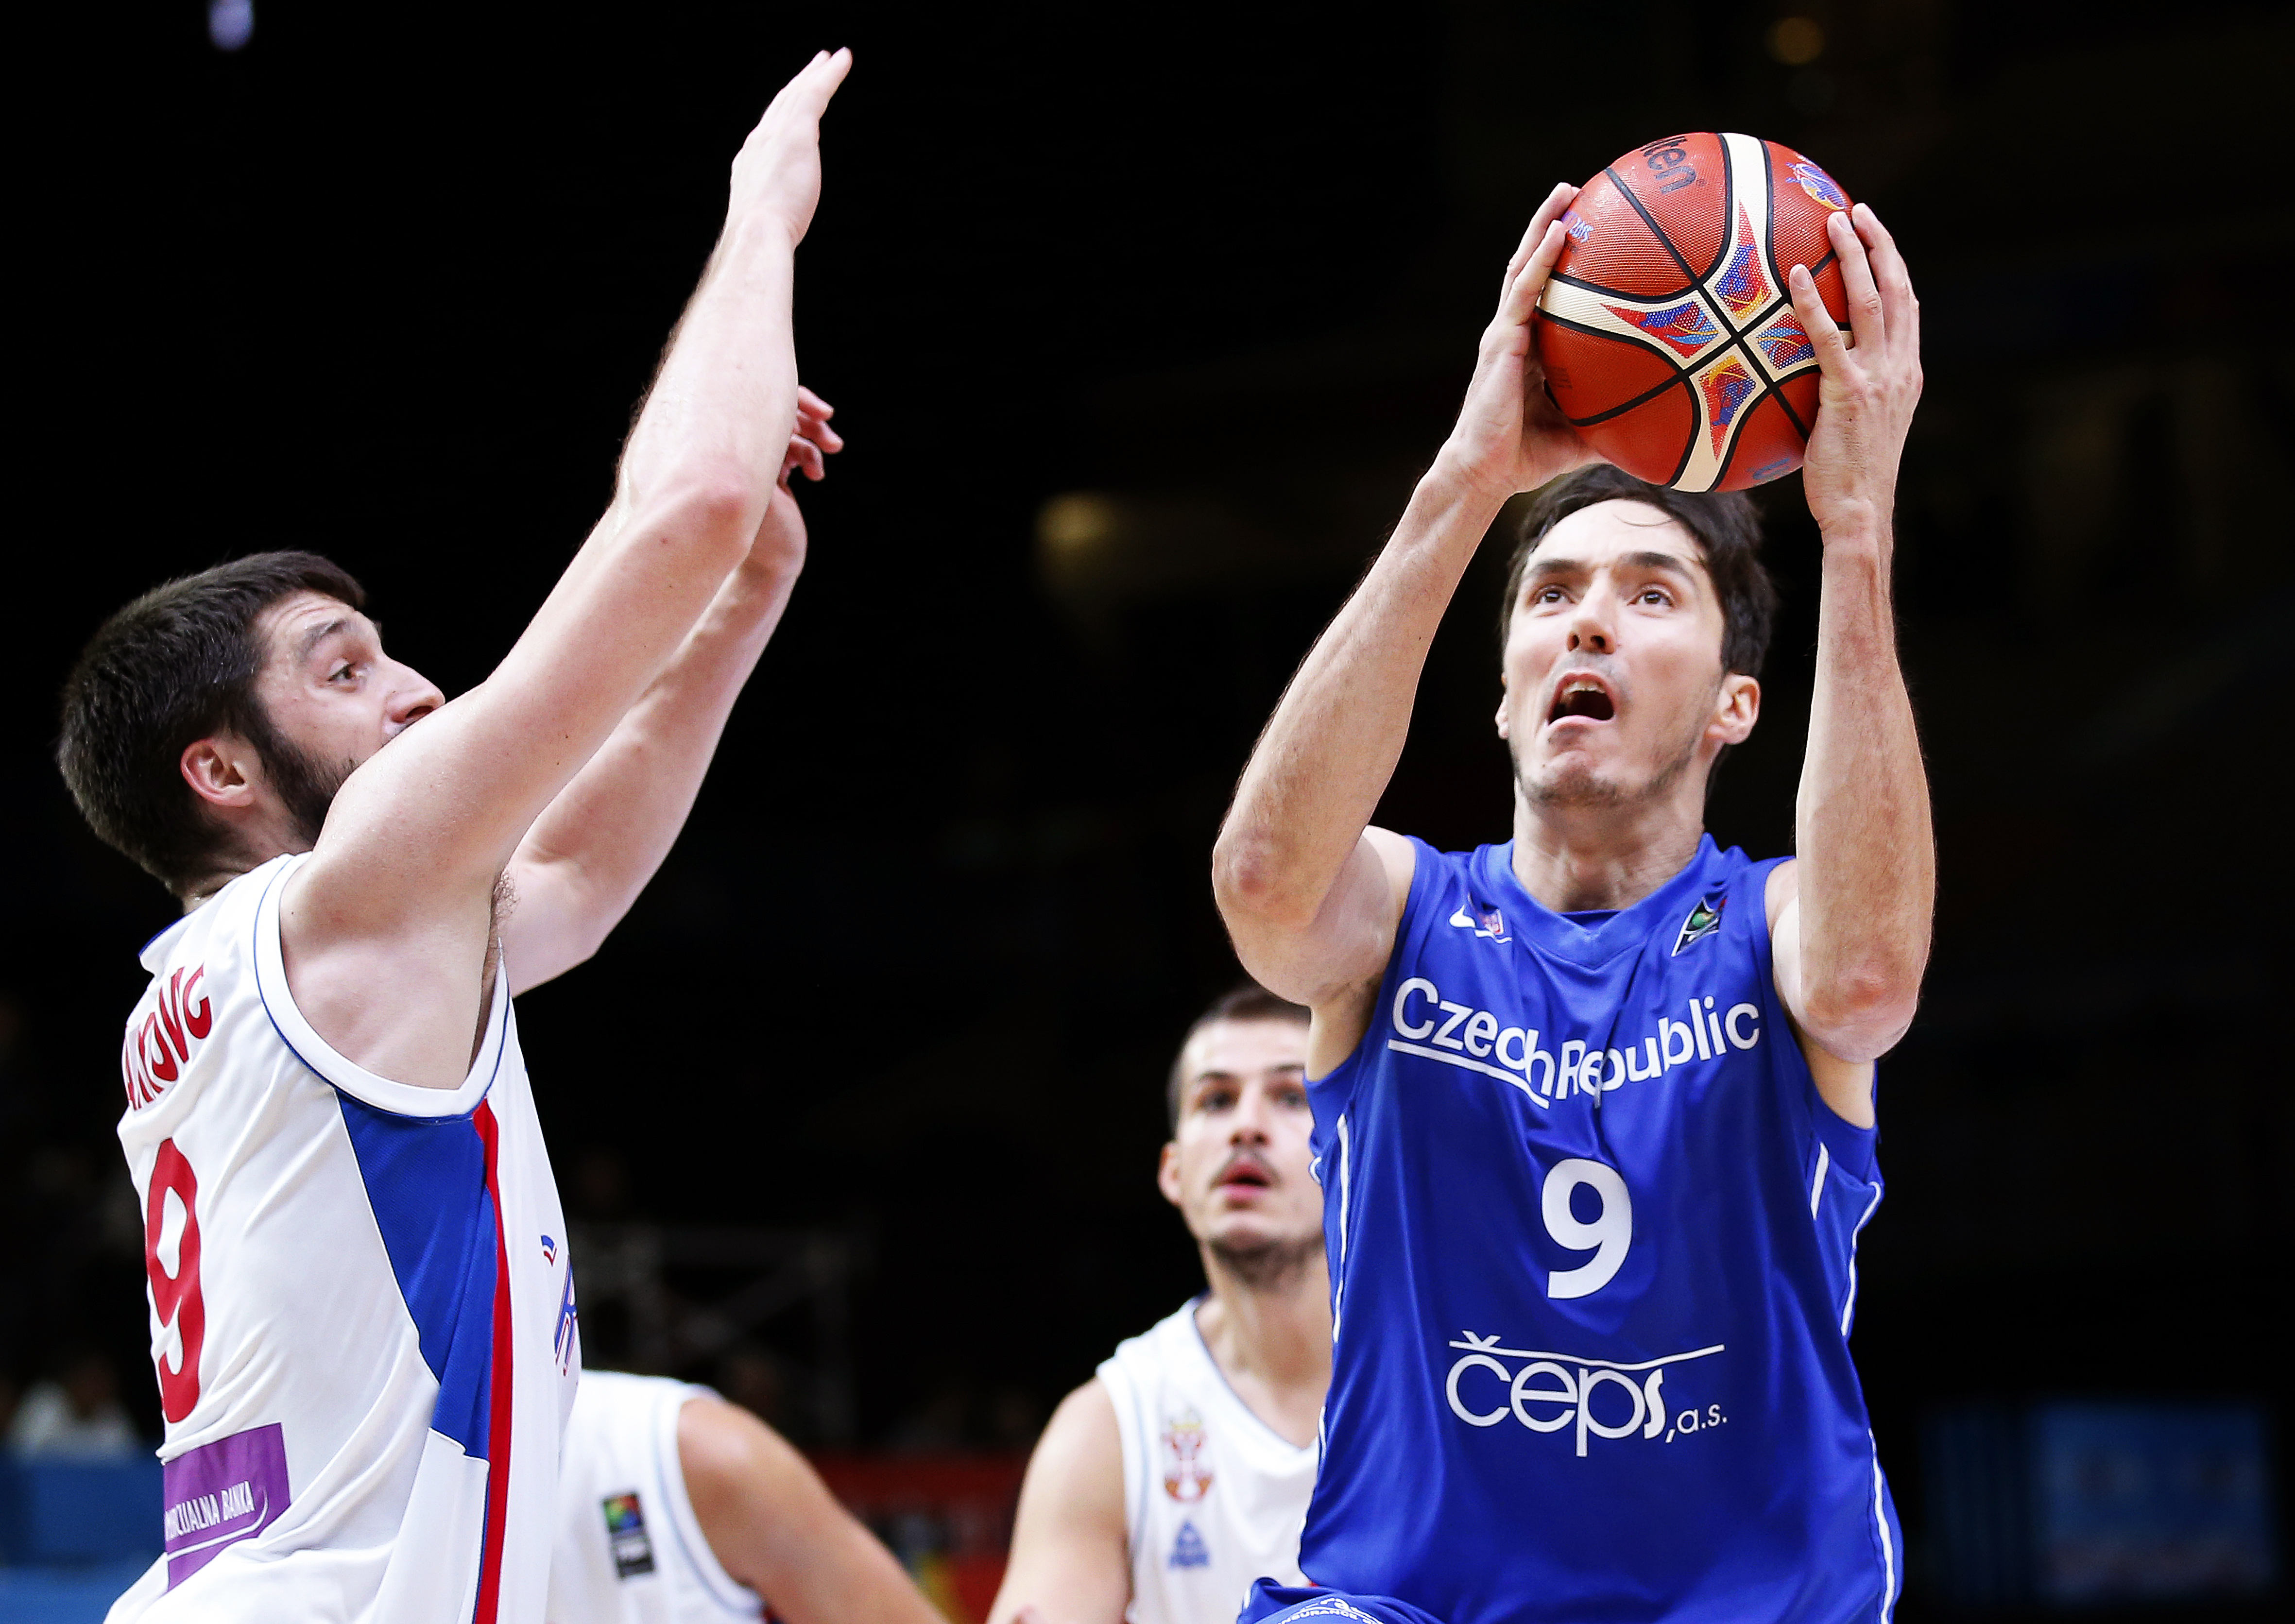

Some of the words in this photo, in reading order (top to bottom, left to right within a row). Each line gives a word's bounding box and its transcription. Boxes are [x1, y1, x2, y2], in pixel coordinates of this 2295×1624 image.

[1640, 136, 1697, 194] lten
[1392, 977, 1557, 1097] Czech
[1555, 996, 1760, 1109] Republic
[146, 1136, 206, 1424] 9
[1541, 1158, 1633, 1299] 9
[1278, 1610, 1358, 1624] NSURANCE
